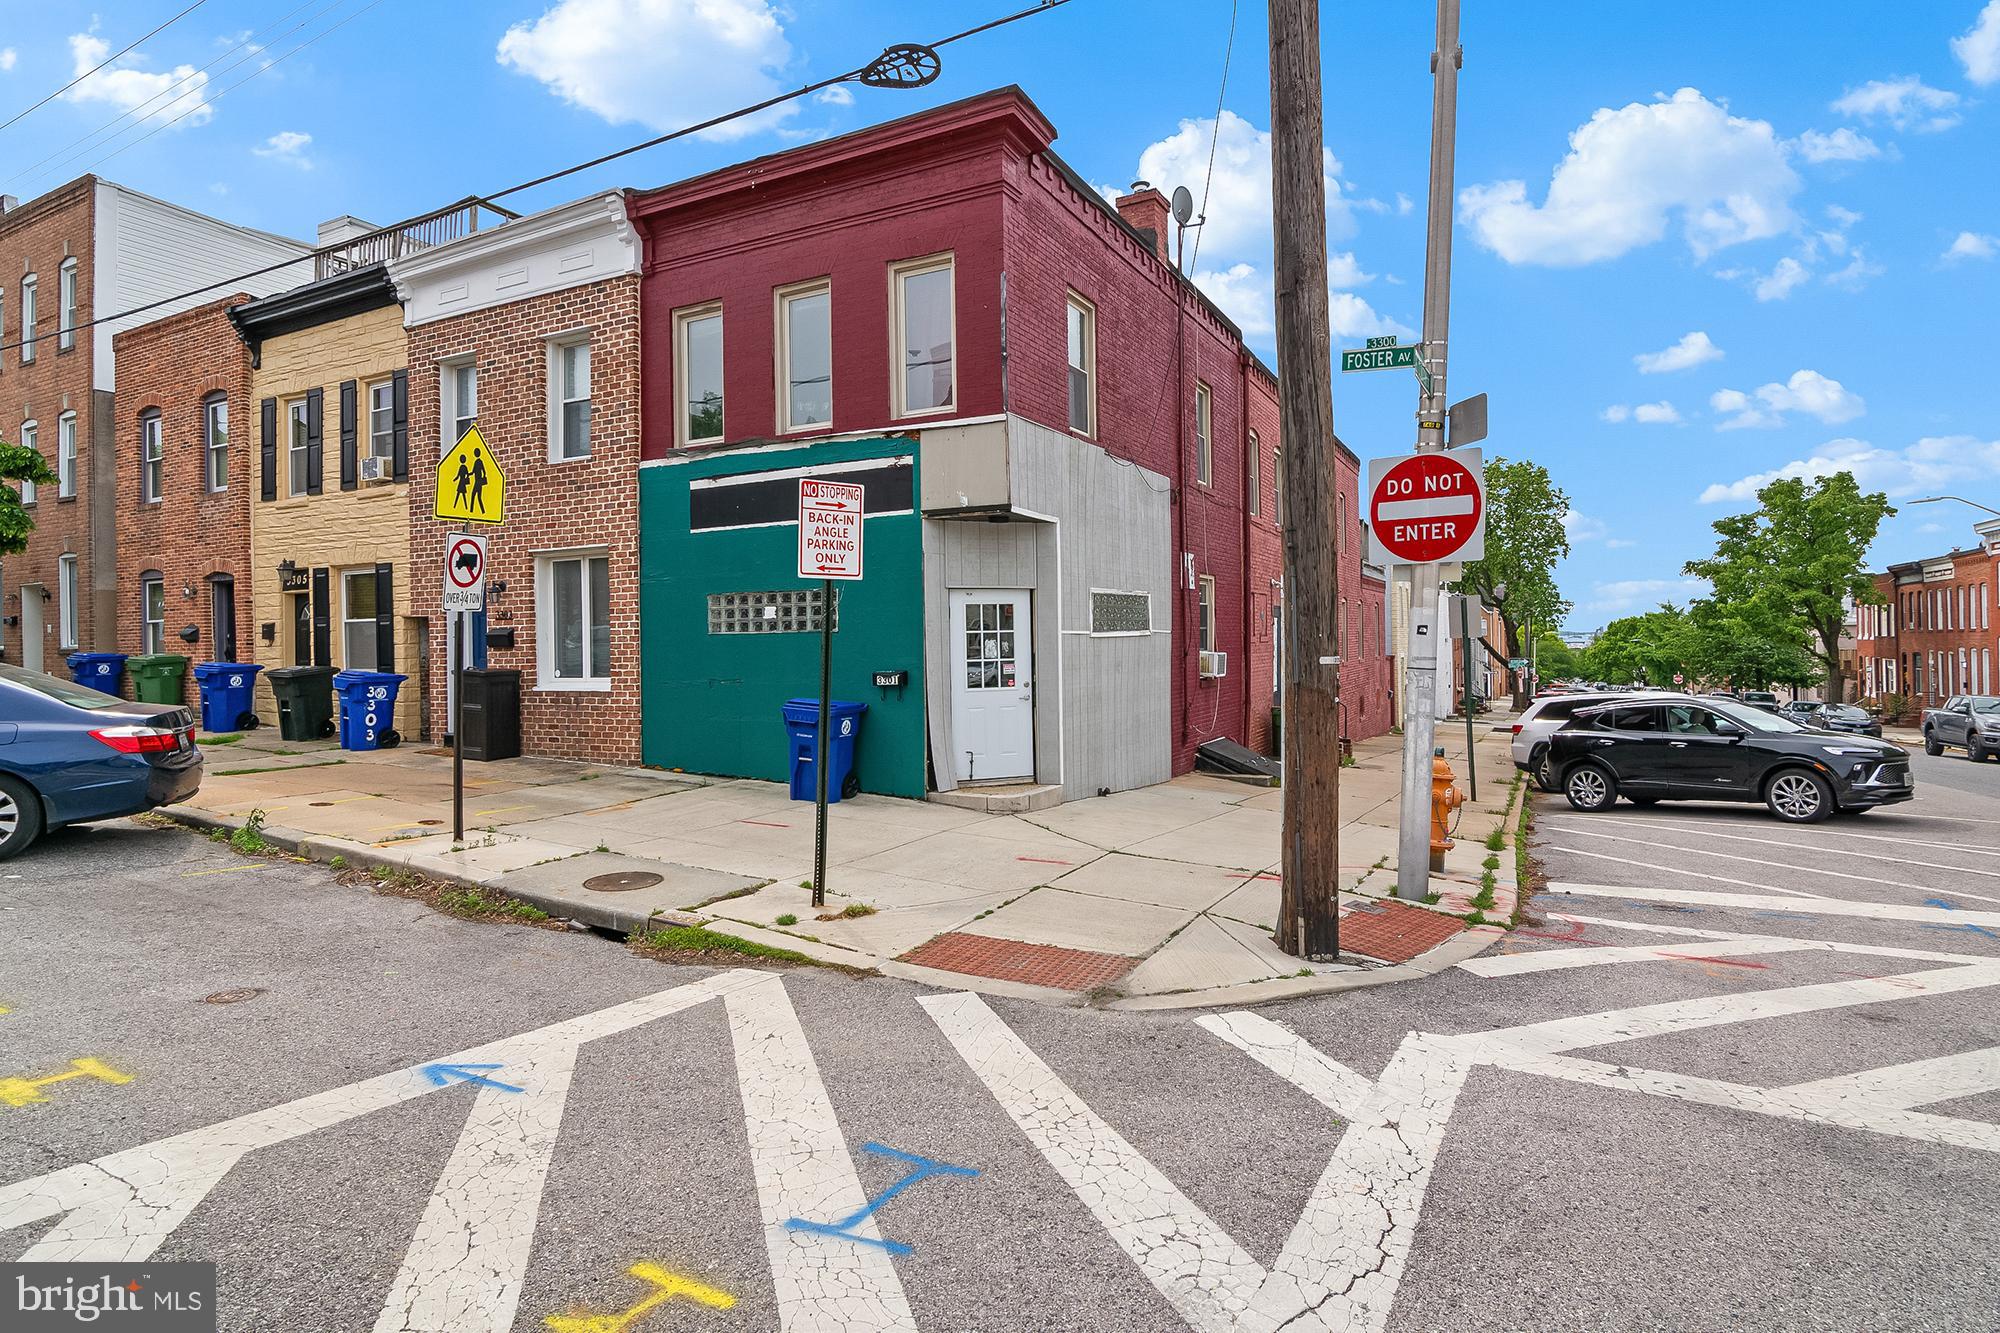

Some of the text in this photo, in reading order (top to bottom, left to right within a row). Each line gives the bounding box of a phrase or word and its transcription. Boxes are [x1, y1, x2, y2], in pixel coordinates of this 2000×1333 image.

[1371, 336, 1396, 348] 3300
[1347, 351, 1394, 369] FOSTER
[1387, 472, 1464, 496] DO NOT
[803, 483, 860, 501] NO STOPPING
[808, 512, 855, 526] BACK-IN
[814, 526, 849, 539] ANGLE
[1394, 522, 1456, 542] ENTER
[807, 538, 854, 552] PARKING
[815, 552, 847, 564] ONLY
[445, 592, 459, 604] OVER
[469, 592, 480, 604] TON
[877, 675, 899, 685] 3301
